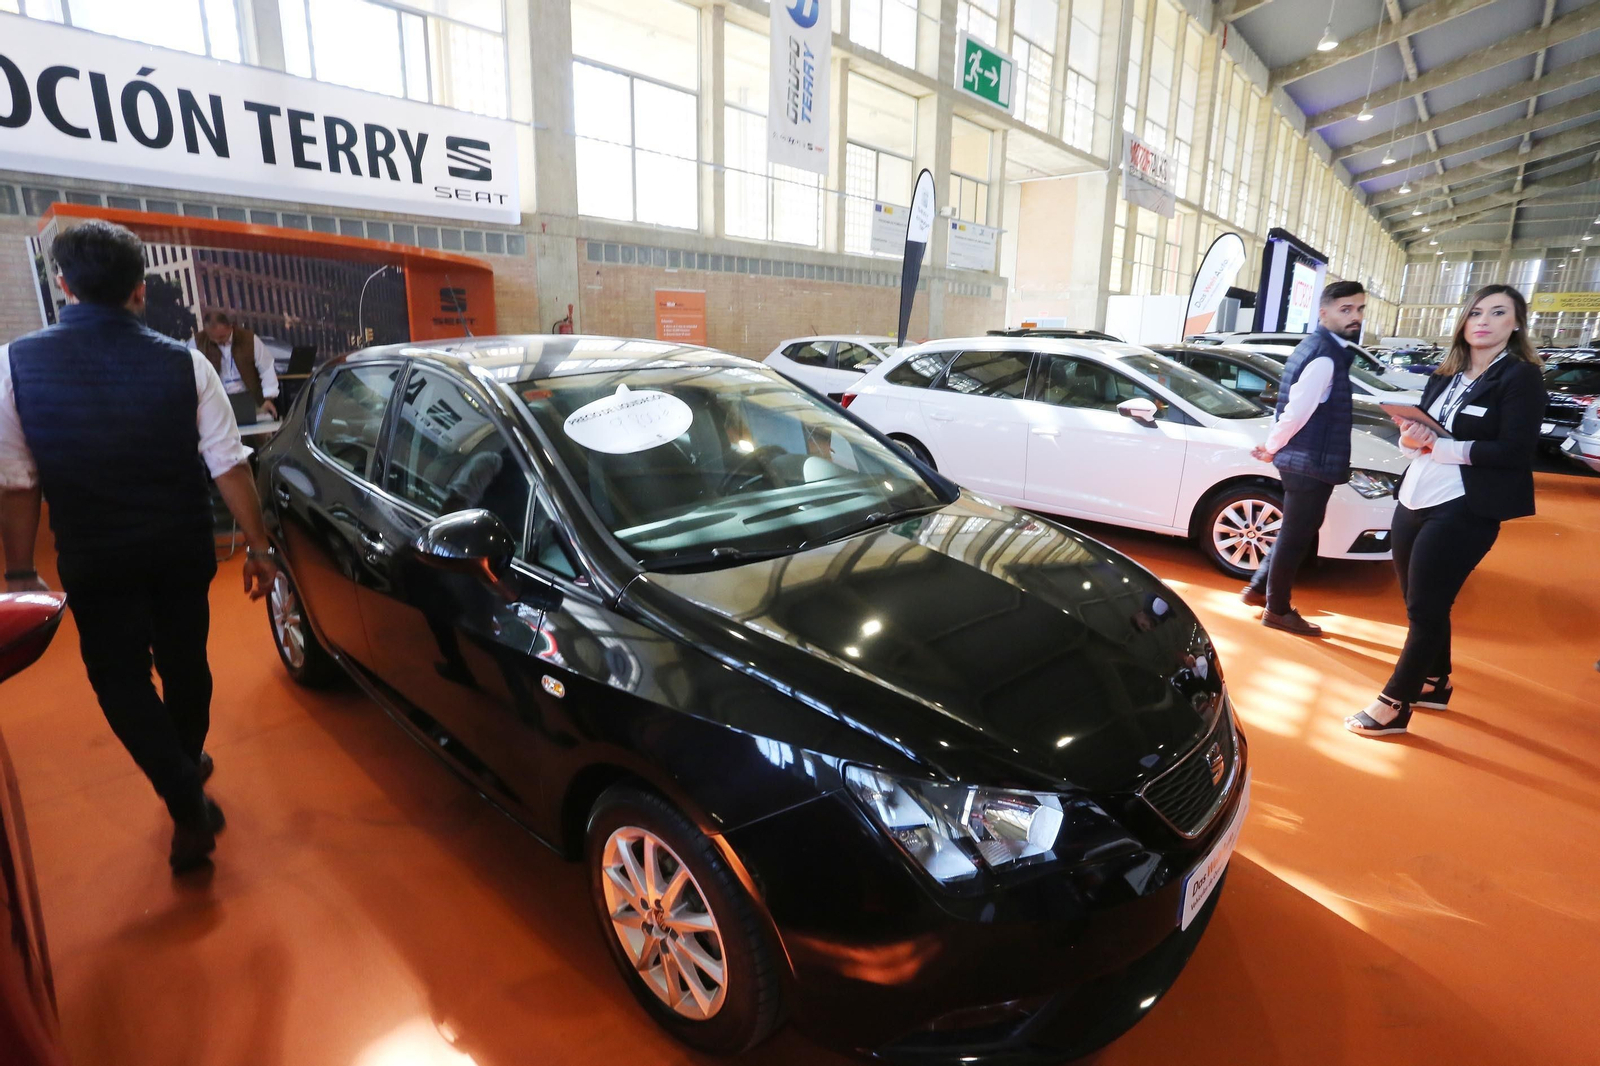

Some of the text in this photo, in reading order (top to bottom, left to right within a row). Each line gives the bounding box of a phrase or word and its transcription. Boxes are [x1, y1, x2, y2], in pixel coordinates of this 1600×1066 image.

[786, 35, 800, 125] GRUPO
[801, 40, 815, 124] TERRY
[244, 100, 429, 184] TERRY
[434, 186, 508, 204] SEAT
[1192, 872, 1207, 898] Das
